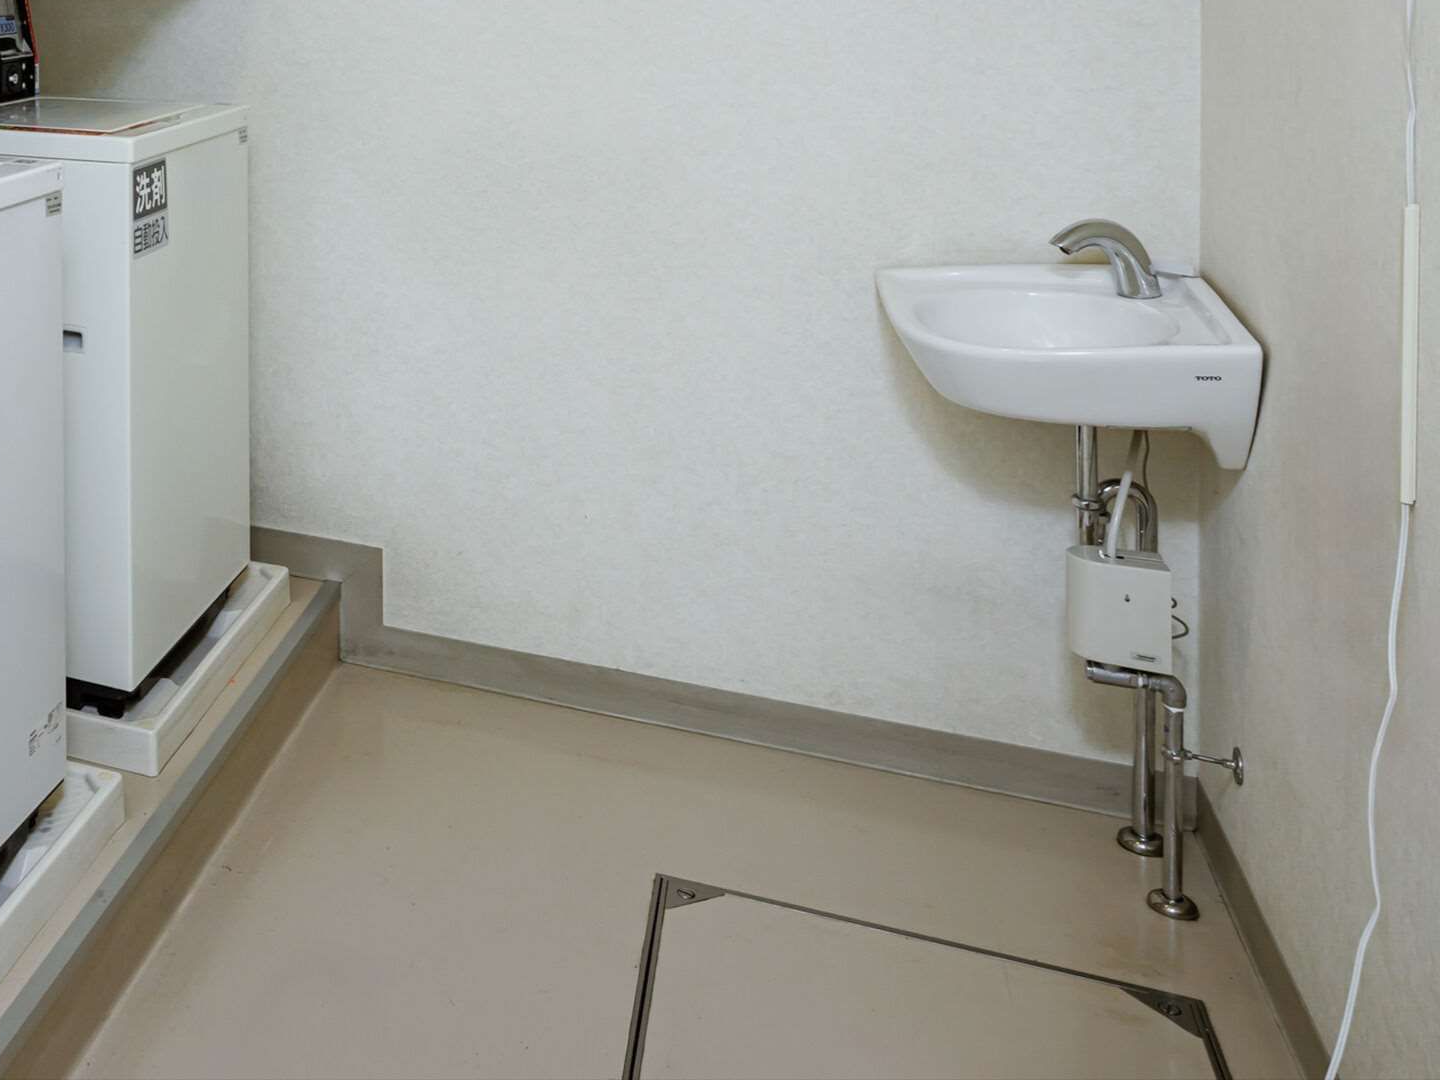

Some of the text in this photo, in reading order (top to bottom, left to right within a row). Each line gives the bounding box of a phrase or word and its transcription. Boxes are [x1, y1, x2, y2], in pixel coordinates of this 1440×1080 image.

[136, 165, 167, 215] 洗剤
[133, 216, 169, 255] 自動投入
